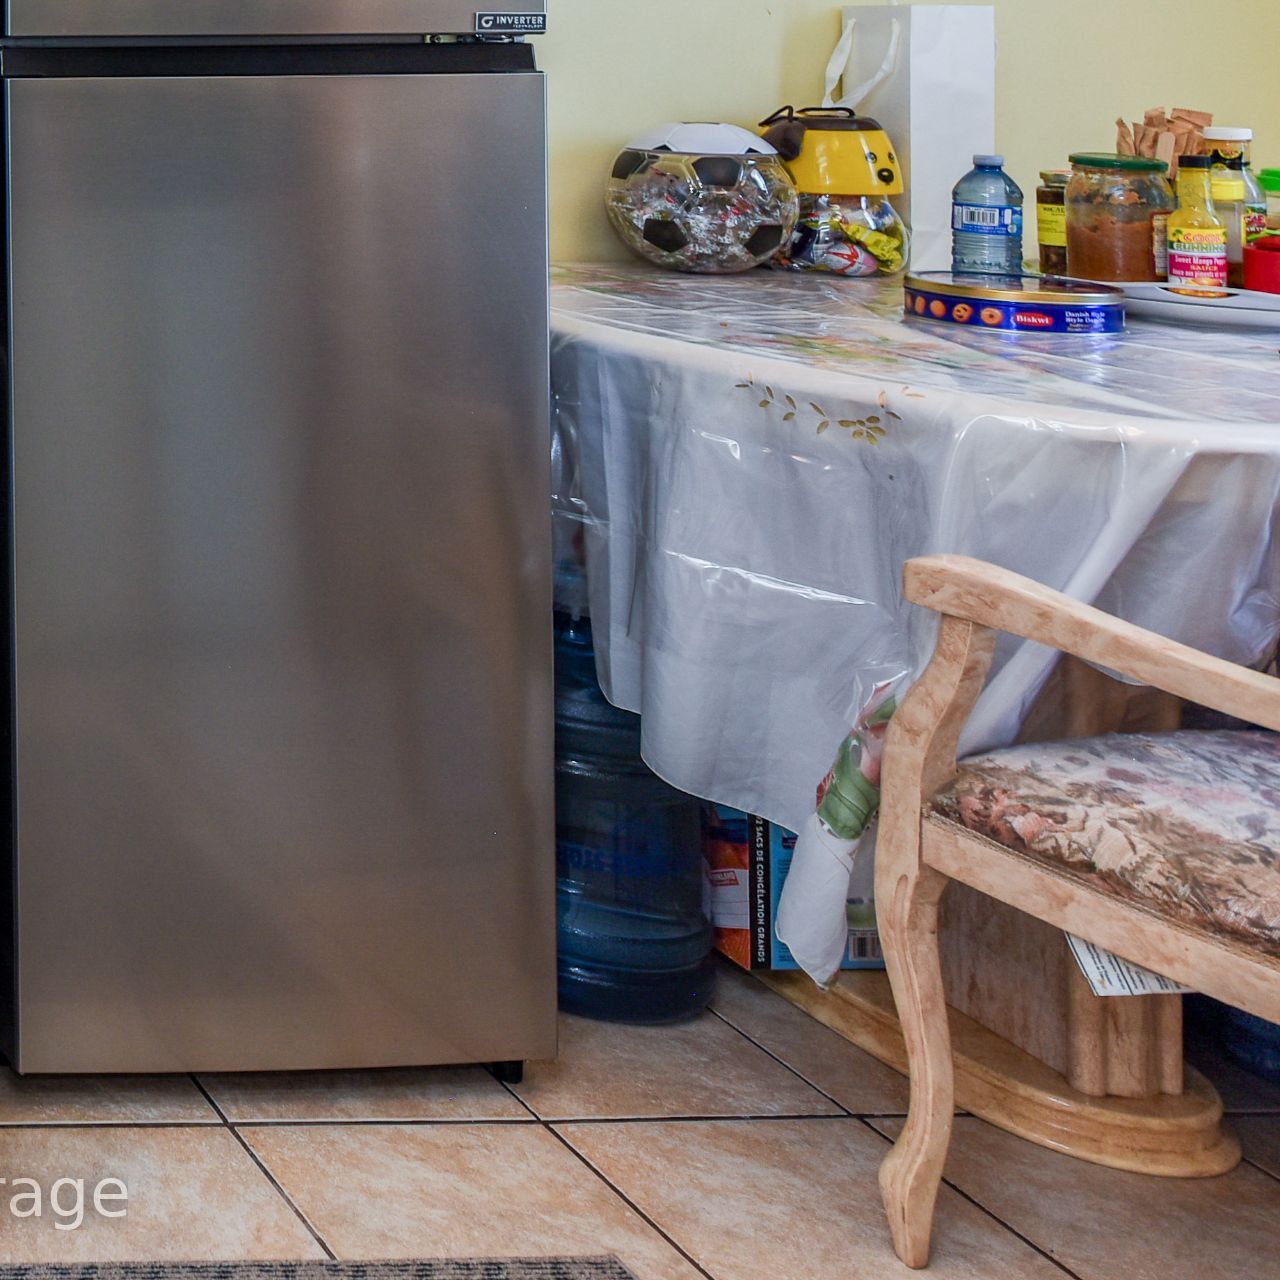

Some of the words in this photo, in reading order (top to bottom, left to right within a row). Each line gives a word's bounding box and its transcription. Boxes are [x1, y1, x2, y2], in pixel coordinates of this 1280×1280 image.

[496, 16, 543, 24] INVERTER
[755, 826, 764, 848] SACS
[756, 850, 764, 862] DE
[756, 863, 765, 924] CONGÉLATION
[757, 928, 765, 963] GRANDS
